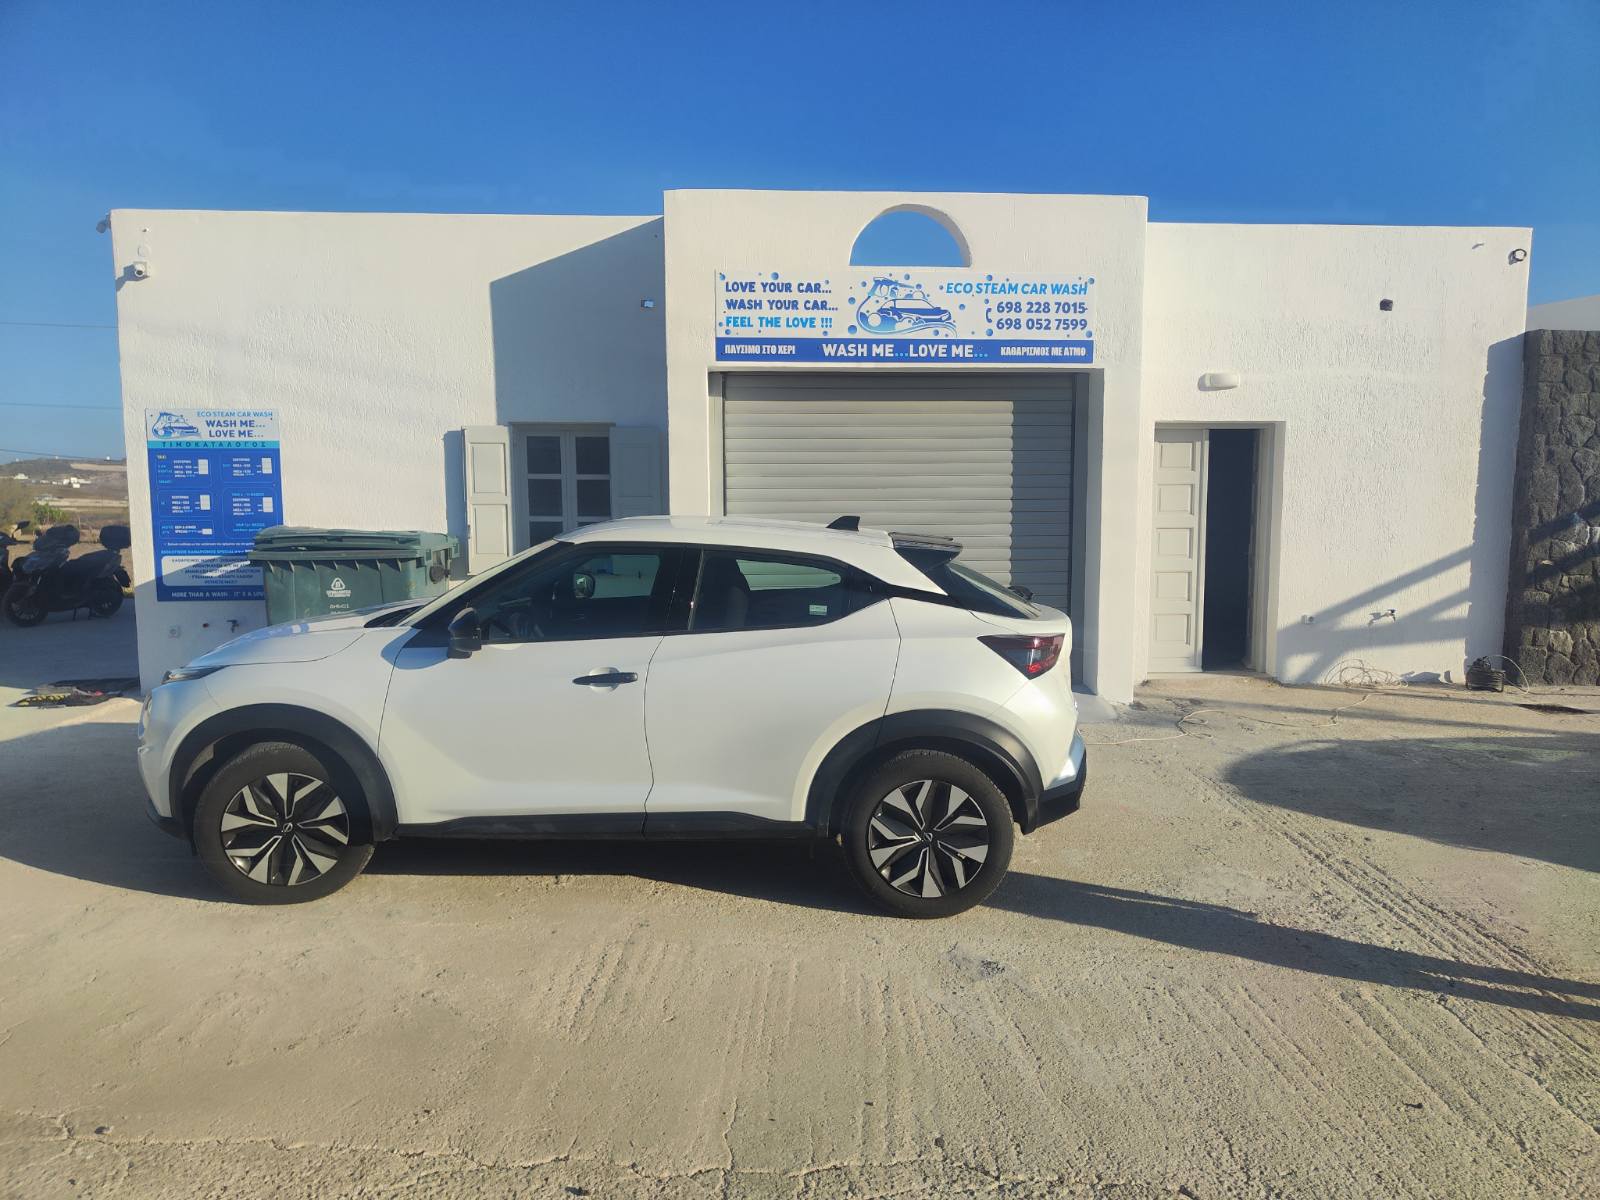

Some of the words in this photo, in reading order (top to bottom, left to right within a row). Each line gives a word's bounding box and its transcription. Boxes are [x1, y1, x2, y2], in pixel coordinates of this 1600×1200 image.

[725, 281, 756, 293] LOVE
[761, 282, 792, 293] YOUR
[797, 282, 832, 294] CAR...
[946, 282, 974, 295] ECO
[975, 282, 1019, 295] STEAM
[1021, 283, 1048, 295] CAR
[1050, 283, 1088, 296] WASH
[725, 299, 763, 311] WASH
[767, 299, 799, 311] YOUR
[804, 300, 839, 311] CAR...
[996, 301, 1023, 314] 698
[1026, 301, 1051, 314] 228
[725, 316, 754, 328] FEEL
[758, 316, 781, 328] THE
[785, 317, 817, 328] LOVE
[996, 318, 1022, 331] 698
[1025, 318, 1052, 331] 052
[1055, 318, 1088, 331] 7599
[778, 345, 796, 355] ΧΕΡΙ
[822, 343, 868, 357] WASH
[1000, 345, 1050, 356] ΚΑΘΑΡΙΣΜΟΣ
[205, 420, 237, 428] WASH
[208, 429, 236, 438] LOVE
